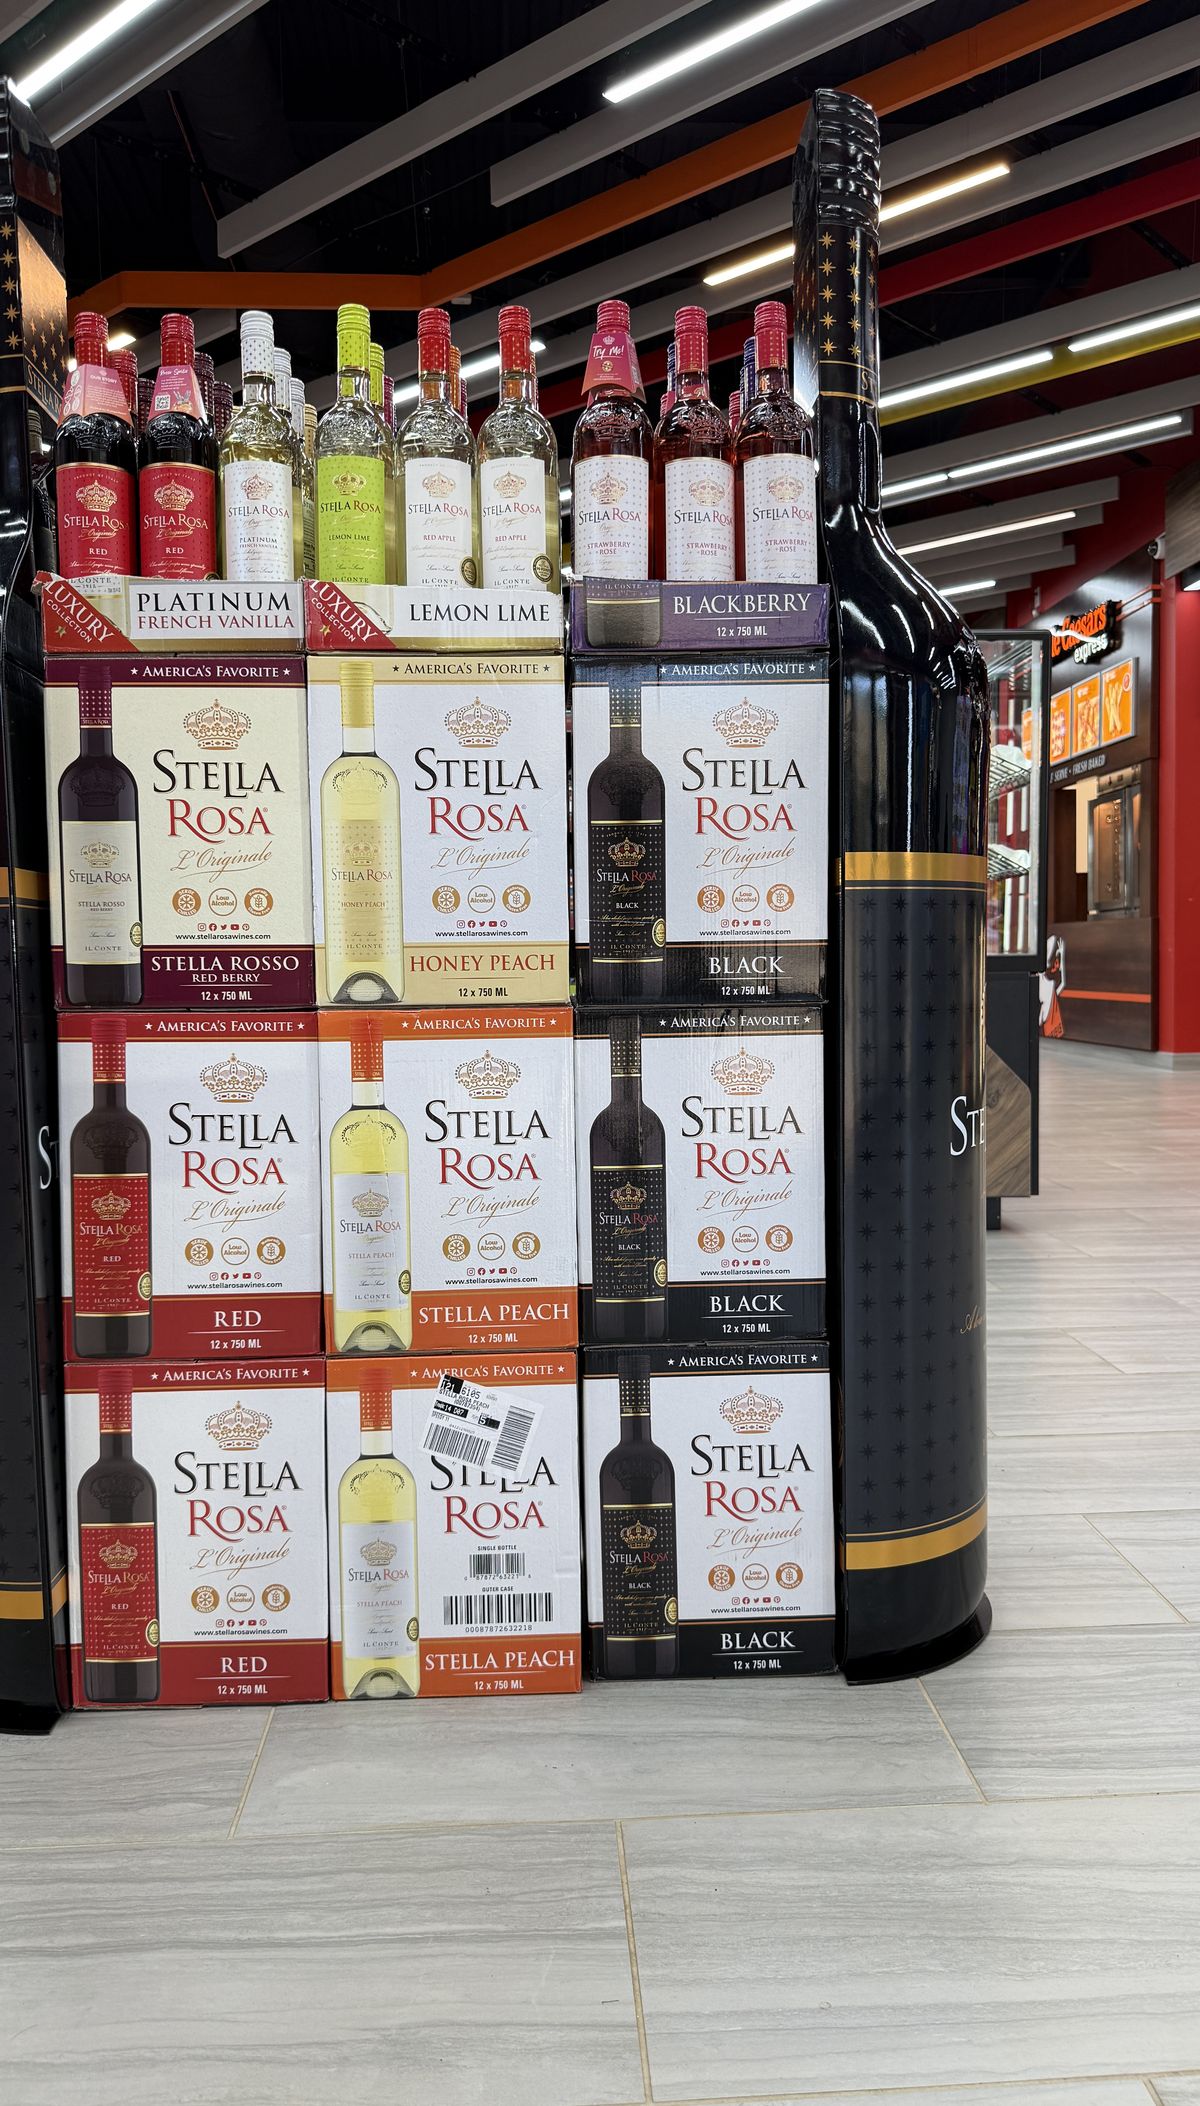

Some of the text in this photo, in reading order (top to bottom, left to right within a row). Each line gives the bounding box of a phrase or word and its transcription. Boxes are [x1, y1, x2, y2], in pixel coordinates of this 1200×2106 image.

[593, 345, 624, 359] Try Me!
[229, 505, 289, 518] STELLA ROSA
[321, 500, 380, 513] STELLA ROSA
[409, 503, 469, 517] STELLA ROSA
[483, 503, 541, 517] STELLA ROSA
[753, 508, 789, 522] STELLA
[144, 514, 208, 529] STELLA ROSA
[579, 508, 640, 525] STELLA ROSA
[137, 592, 292, 611] PLATINUM
[674, 593, 811, 614] BLACKBERRY
[45, 580, 115, 642] LUXURY
[309, 580, 378, 642] LUXURY
[410, 604, 550, 621] LEMON LIME
[47, 599, 92, 643] COLLECTION
[139, 615, 294, 629] FRENCH VANILLA
[312, 598, 355, 642] COLLECTION
[717, 628, 726, 636] 12
[737, 627, 751, 636] 750
[754, 626, 767, 635] ML
[143, 666, 279, 677] AMERICA'S FAVORITE
[405, 663, 538, 674] AMERICA'S FAVORITE
[672, 663, 805, 675] AMERICA'S FAVORITE
[153, 749, 283, 798] STELLA
[415, 748, 541, 796] STELLA
[682, 748, 807, 795] STELLA
[167, 799, 272, 844] ROSA
[427, 797, 530, 842] ROSA
[694, 797, 796, 842] ROSA
[170, 841, 272, 883] L'Originale
[431, 838, 529, 880] L'Originale
[696, 837, 795, 879] L'Originale
[69, 870, 103, 884] STELLA
[597, 869, 629, 883] STELLA
[151, 956, 299, 972] STELLA ROSSO
[410, 955, 555, 972] HONEY PEACH
[709, 957, 784, 974] BLACK
[192, 974, 260, 982] RED BERRY
[201, 992, 210, 1000] 12
[222, 992, 236, 1000] 750
[239, 991, 252, 1000] ML
[459, 988, 468, 997] 12
[478, 988, 492, 997] 750
[496, 988, 508, 996] ML
[722, 987, 731, 995] 12
[741, 986, 755, 995] 750
[758, 986, 770, 995] ML
[157, 1020, 293, 1032] AMERICA'S FAVORITE
[414, 1017, 545, 1030] AMERICA'S FAVORITE
[671, 1016, 800, 1028] AMERICA'S FAVORITE
[169, 1103, 298, 1149] STELLA
[425, 1100, 551, 1145] STELLA
[682, 1096, 804, 1140] STELLA
[437, 1148, 540, 1189] ROSA
[694, 1143, 795, 1183] ROSA
[182, 1151, 286, 1194] ROSA
[441, 1186, 539, 1228] L'Originale
[696, 1180, 792, 1221] L'Originale
[184, 1191, 286, 1232] L'Originale
[340, 1220, 373, 1233] STELLA
[445, 1276, 538, 1285] www.stellarosawines.com
[700, 1268, 790, 1276] www.stellarosawines.com
[188, 1281, 282, 1289] www.stellarosawines.com
[710, 1295, 785, 1313] BLACK
[214, 1310, 262, 1327] RED
[419, 1304, 568, 1323] STELLA PEACH
[211, 1340, 220, 1349] 12
[231, 1339, 245, 1349] 750
[249, 1339, 261, 1348] ML
[679, 1354, 807, 1367] AMERICA'S FAVORITE
[163, 1369, 298, 1382] AMERICA'S FAVORITE
[493, 1365, 554, 1376] FAVORITE
[691, 1435, 812, 1478] STELLA
[174, 1452, 301, 1496] STELLA
[703, 1481, 804, 1521] ROSA
[187, 1500, 292, 1542] ROSA
[443, 1496, 549, 1539] ROSA
[707, 1518, 802, 1558] L'Originale
[189, 1537, 290, 1580] L'Originale
[711, 1605, 801, 1614] www.stellarosawines.com
[194, 1627, 287, 1636] www.stellarosawines.com
[721, 1632, 795, 1650] BLACK
[221, 1656, 268, 1673] RED
[425, 1651, 574, 1670] STELLA PEACH
[734, 1661, 742, 1669] 12
[753, 1660, 766, 1669] 750
[769, 1659, 781, 1668] ML
[218, 1685, 227, 1694] 12
[238, 1685, 252, 1693] 750
[254, 1685, 268, 1693] ML
[475, 1681, 484, 1690] 12
[494, 1681, 508, 1689] 750
[511, 1680, 524, 1688] ML
